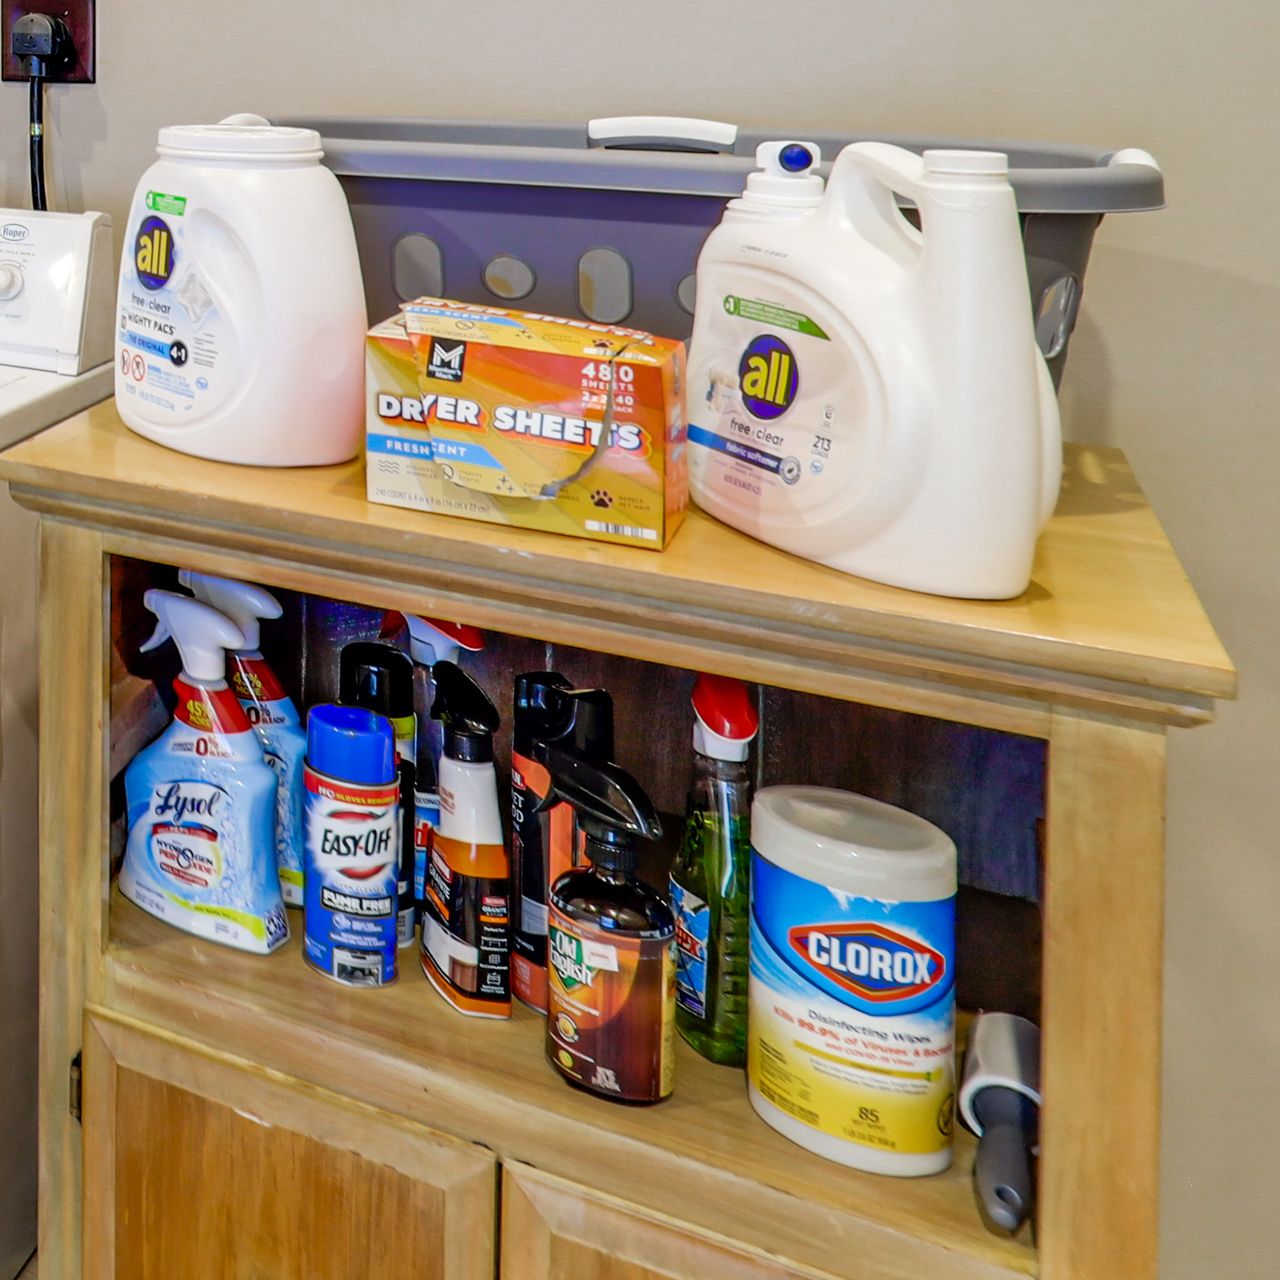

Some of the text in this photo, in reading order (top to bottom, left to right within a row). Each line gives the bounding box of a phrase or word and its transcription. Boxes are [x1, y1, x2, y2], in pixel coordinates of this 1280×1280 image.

[2, 226, 26, 238] Roper
[136, 228, 168, 277] all
[148, 298, 172, 314] clear
[153, 320, 175, 336] PACS
[743, 349, 790, 406] all
[377, 393, 642, 451] DRYER SHEETS
[729, 417, 785, 447] free clear
[385, 439, 430, 456] FRESH
[812, 434, 832, 452] 213
[154, 782, 221, 822] Lysol
[318, 785, 336, 799] NO
[555, 930, 578, 961] Old
[807, 930, 932, 985] CLOROX
[550, 939, 593, 988] English
[797, 1018, 842, 1041] 99.9%
[807, 1008, 889, 1041] Disinfecting
[858, 1106, 880, 1123] 85
